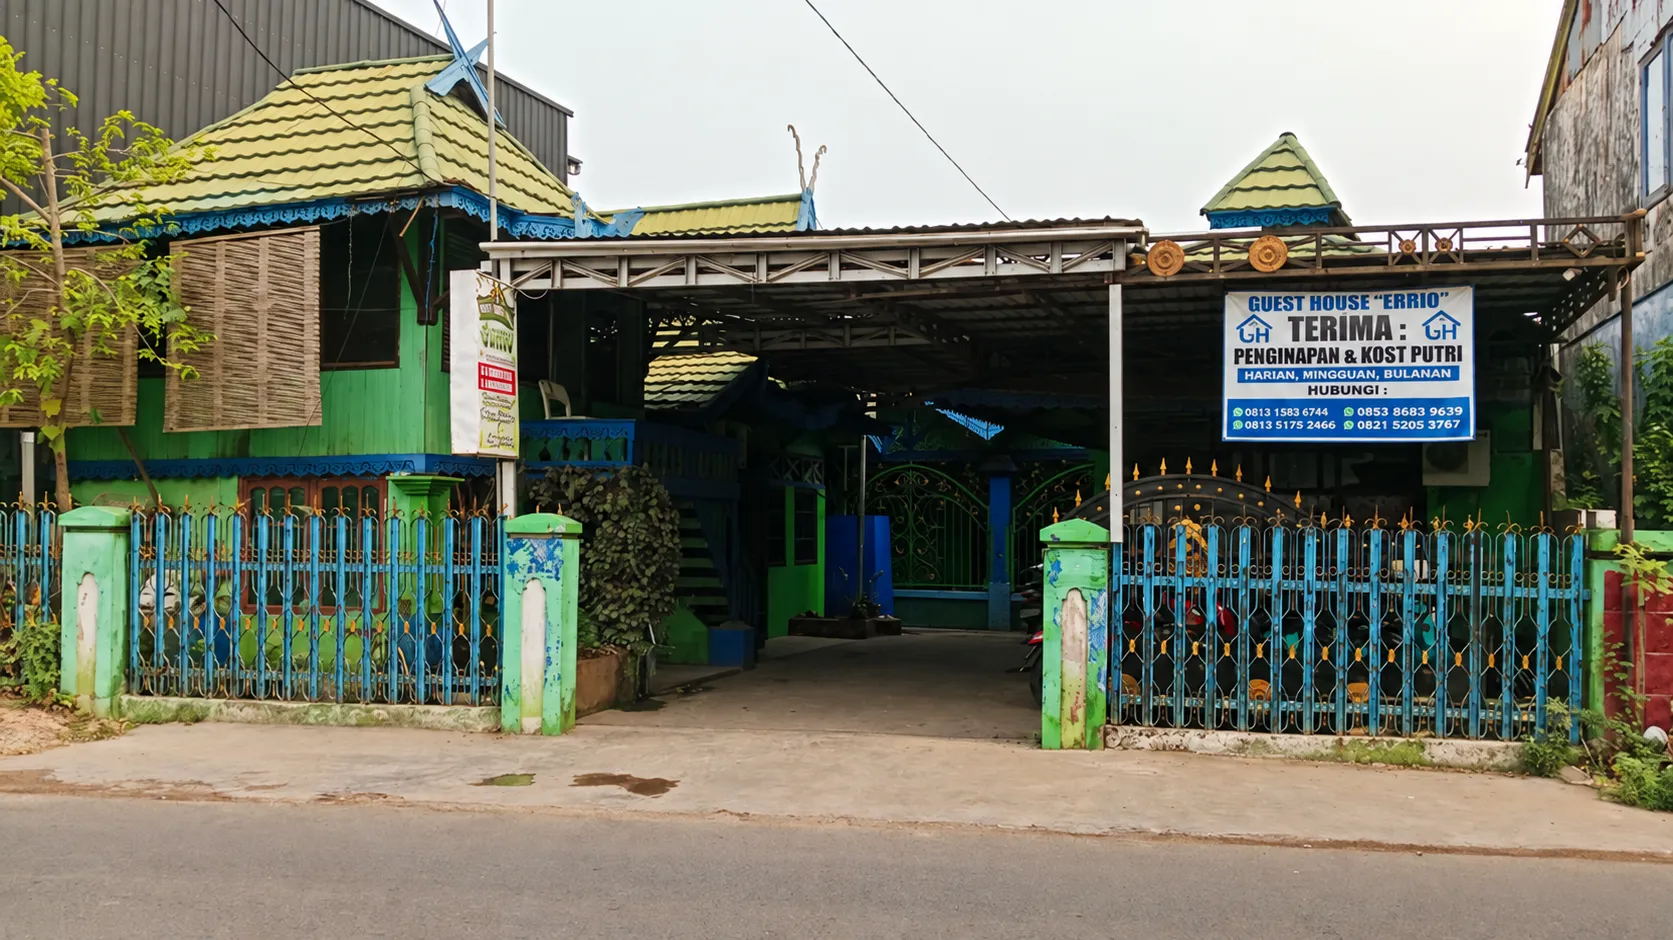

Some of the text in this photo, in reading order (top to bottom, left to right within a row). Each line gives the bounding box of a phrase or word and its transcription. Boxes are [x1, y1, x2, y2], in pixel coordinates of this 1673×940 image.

[1248, 295, 1305, 313] GUEST
[1309, 294, 1370, 311] HOUSE
[1287, 314, 1394, 343] TERIMA
[1233, 344, 1463, 366] PENGINAPAN & KOST PUTRI
[1244, 368, 1452, 382] HARIAN, MINGGUAN, BULANAN
[1307, 384, 1380, 396] HUBUNGI
[1244, 407, 1330, 418] 0813 1583 6744
[1356, 405, 1463, 417] 0853 8683 9639
[1244, 420, 1337, 430] 0813 5175 2466
[1356, 419, 1461, 431] 0821 5205 3767
